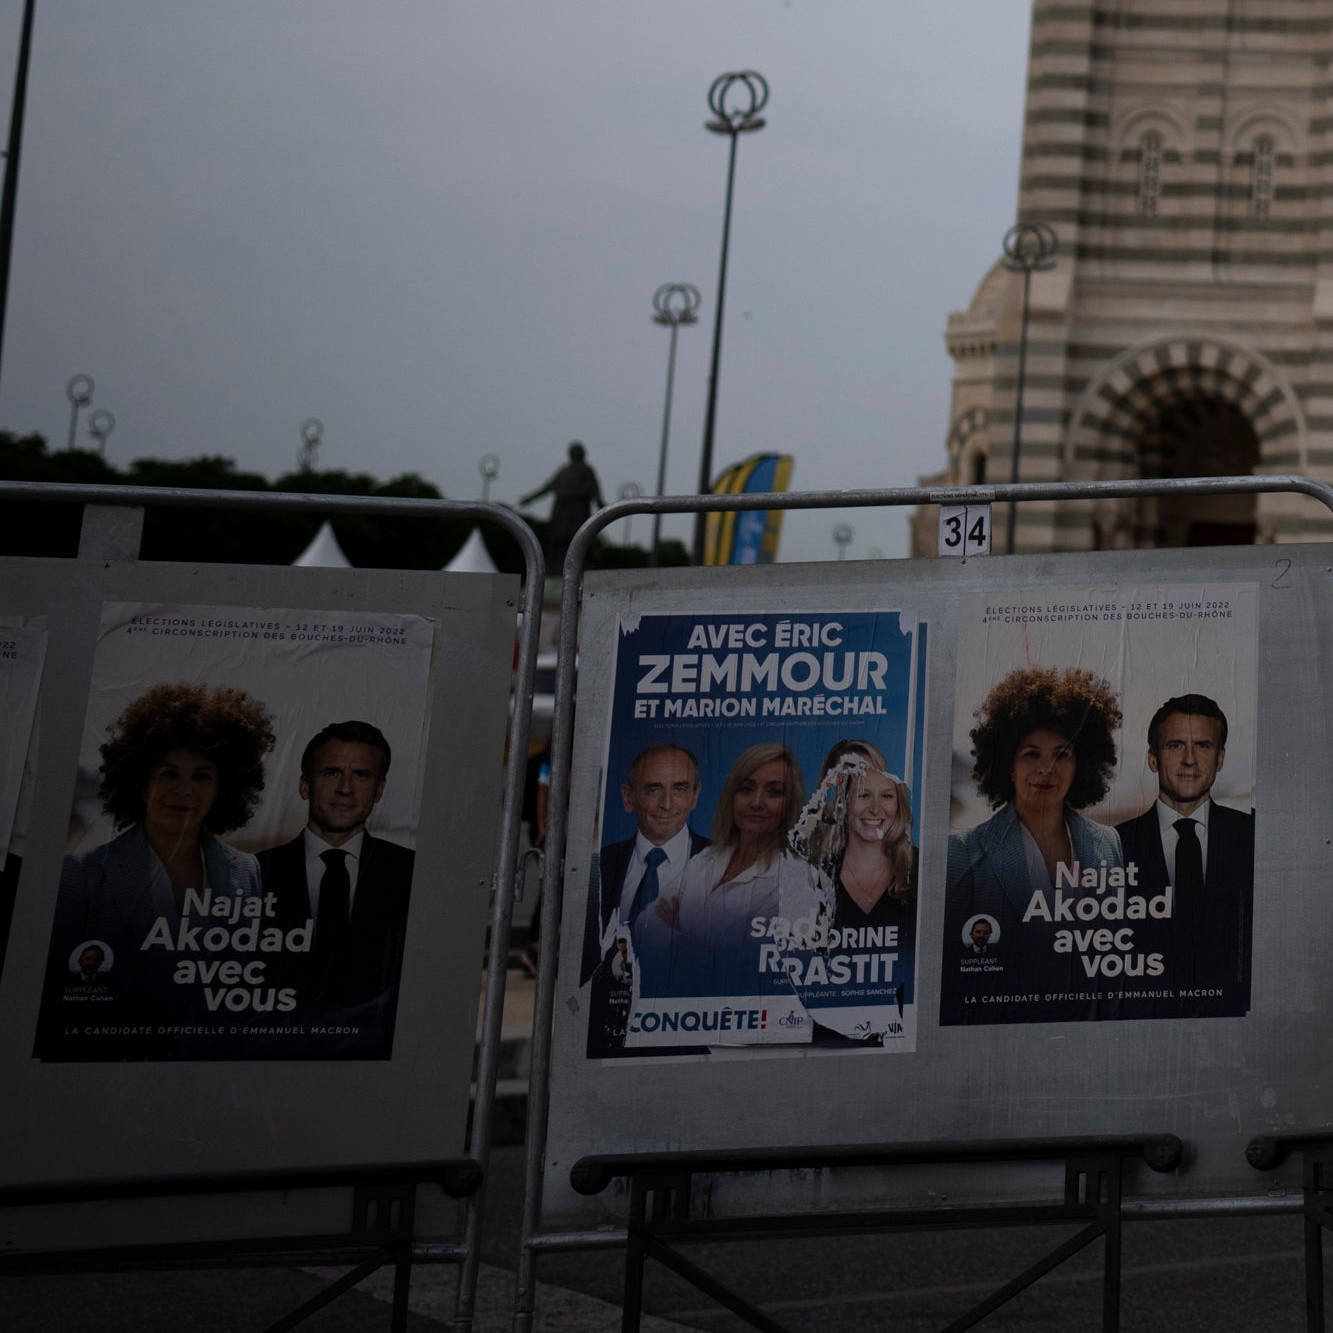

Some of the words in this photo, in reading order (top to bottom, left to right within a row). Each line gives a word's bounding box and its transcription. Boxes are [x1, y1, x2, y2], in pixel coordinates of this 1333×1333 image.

[1271, 558, 1292, 590] 2
[986, 606, 1042, 614] ÉLECTIONS
[1047, 604, 1117, 612] LÉGISLATIVES
[1004, 614, 1098, 623] CIRCONSCRIPTION
[1126, 610, 1232, 620] BOUCHES-DU-RHÔNE
[131, 615, 196, 626] ÉLECTIONS
[201, 618, 281, 630] LÉGISLATIVES
[687, 623, 768, 649] AVEC
[775, 620, 843, 648] ÉRIC
[152, 627, 259, 639] CIRCONSCRIPTION
[264, 632, 285, 640] DES
[290, 633, 408, 644] BOUCHES-DU-RHÔNE
[636, 651, 888, 694] ZEMMOUR
[634, 699, 660, 718] ET
[664, 697, 760, 718] MARION
[763, 693, 887, 716] MARÉCHAL
[1055, 860, 1138, 894] Najat
[181, 887, 278, 924] Najat
[1022, 886, 1172, 922] Akodad
[140, 917, 313, 951] Akodad
[1053, 927, 1134, 953] avec
[173, 960, 265, 984] avec
[1080, 953, 1164, 977] vous
[203, 987, 298, 1012] vous
[841, 988, 865, 996] SOPHIE
[866, 987, 897, 995] SANCHEZ
[981, 994, 1040, 1003] CANDIDATE
[1044, 992, 1103, 1001] OFFICIELLE
[1108, 990, 1175, 999] D'EMMANUEL
[1179, 989, 1222, 997] MACRON
